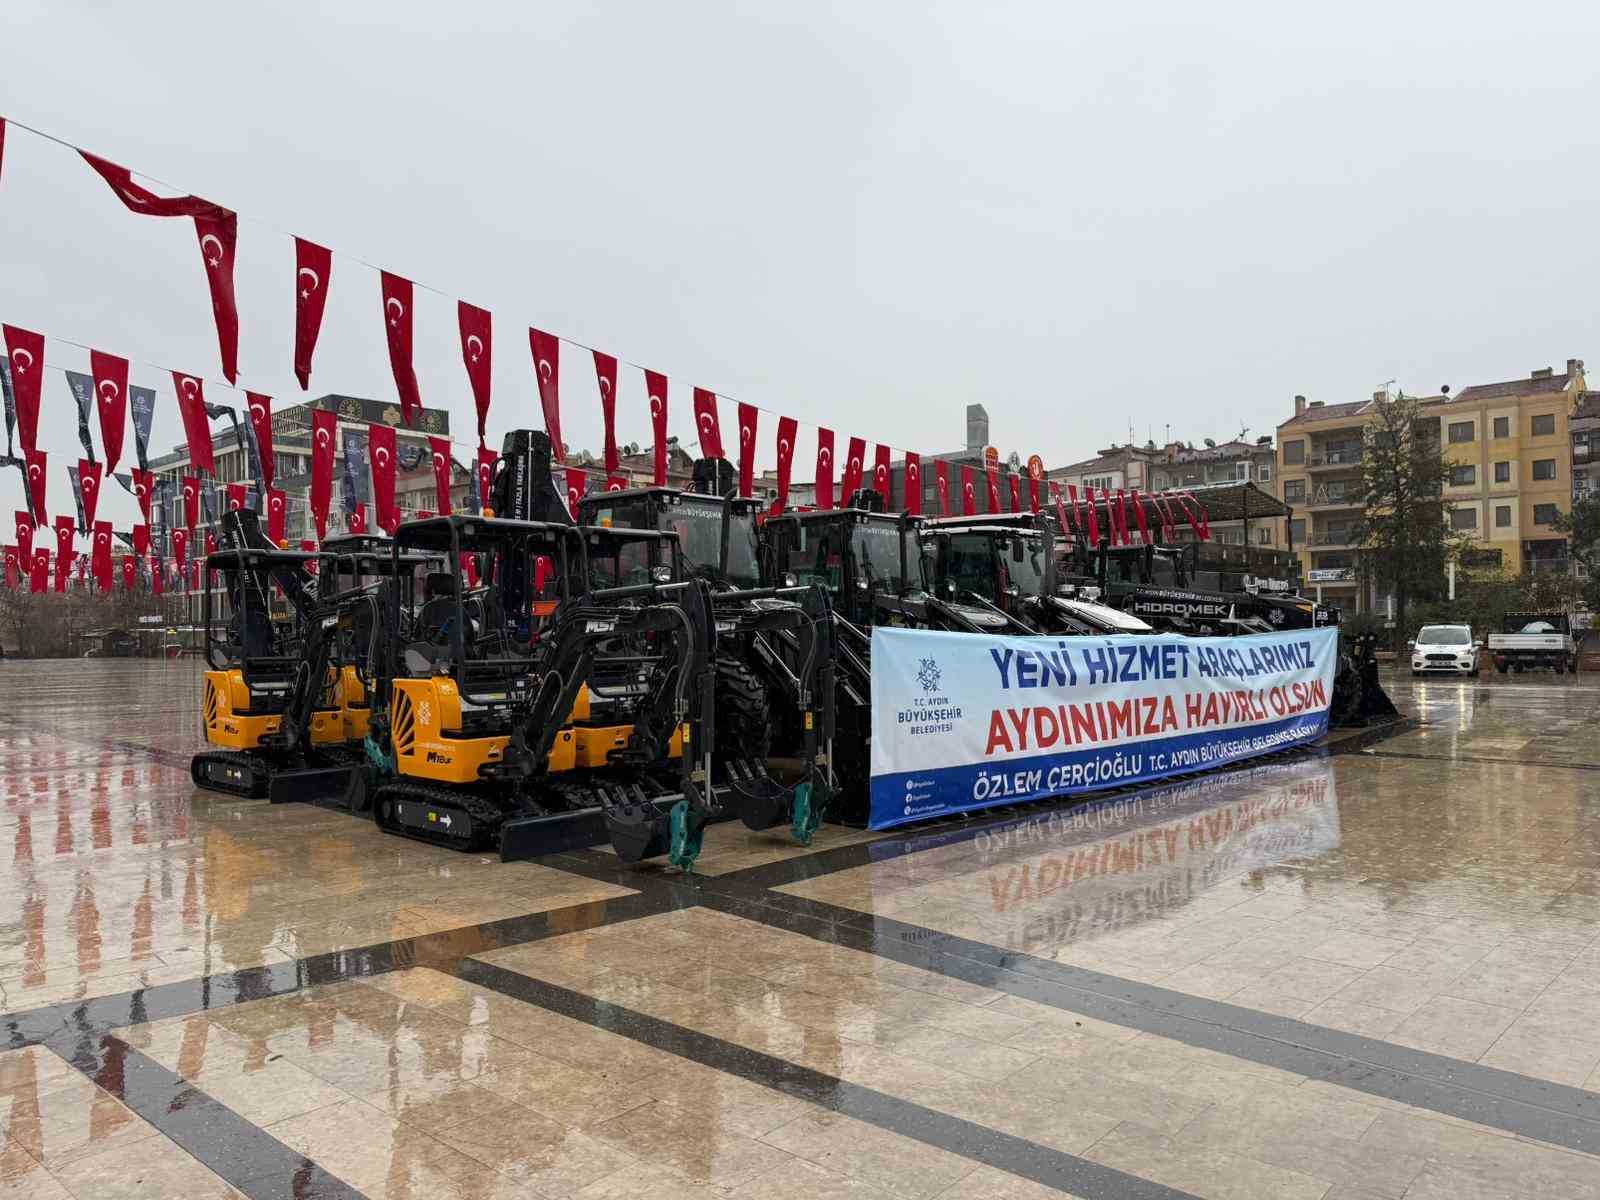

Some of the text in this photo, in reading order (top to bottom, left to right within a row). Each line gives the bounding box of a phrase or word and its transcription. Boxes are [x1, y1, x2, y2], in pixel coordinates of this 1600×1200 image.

[990, 640, 1316, 689] YENİ HİZMET ARAÇLARIMIZ
[898, 706, 963, 723] BÜYÜKŞEHİR
[928, 697, 949, 706] AYDIN
[985, 679, 1327, 755] AYDINIMIZA HAYIRLI OLSUN
[911, 722, 953, 735] BELEDİYESİ
[973, 769, 1042, 800] ÖZLEM
[1047, 752, 1143, 792] ÇERÇİOĞLU
[1149, 755, 1168, 771] T.C.
[1171, 749, 1200, 767] AYDIN
[1200, 735, 1250, 760] BÜYÜKŞEHİR
